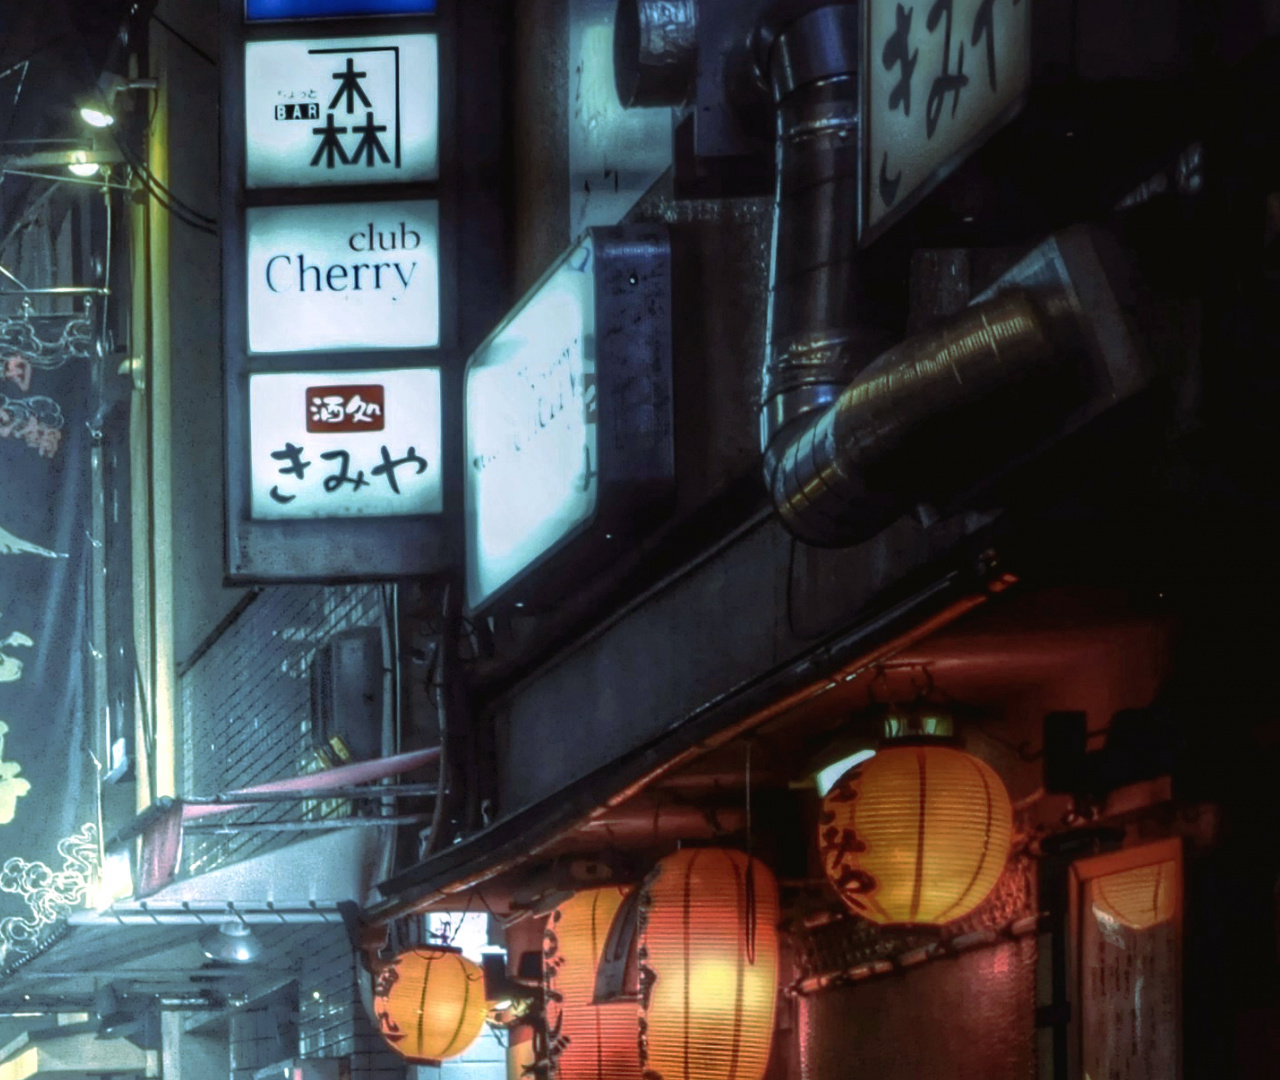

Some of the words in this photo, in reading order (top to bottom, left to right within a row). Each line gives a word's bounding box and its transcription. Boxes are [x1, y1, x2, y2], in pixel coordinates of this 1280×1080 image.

[276, 103, 318, 120] BAR
[348, 222, 421, 253] club
[265, 254, 417, 294] Cherry
[269, 442, 428, 504] きみや
